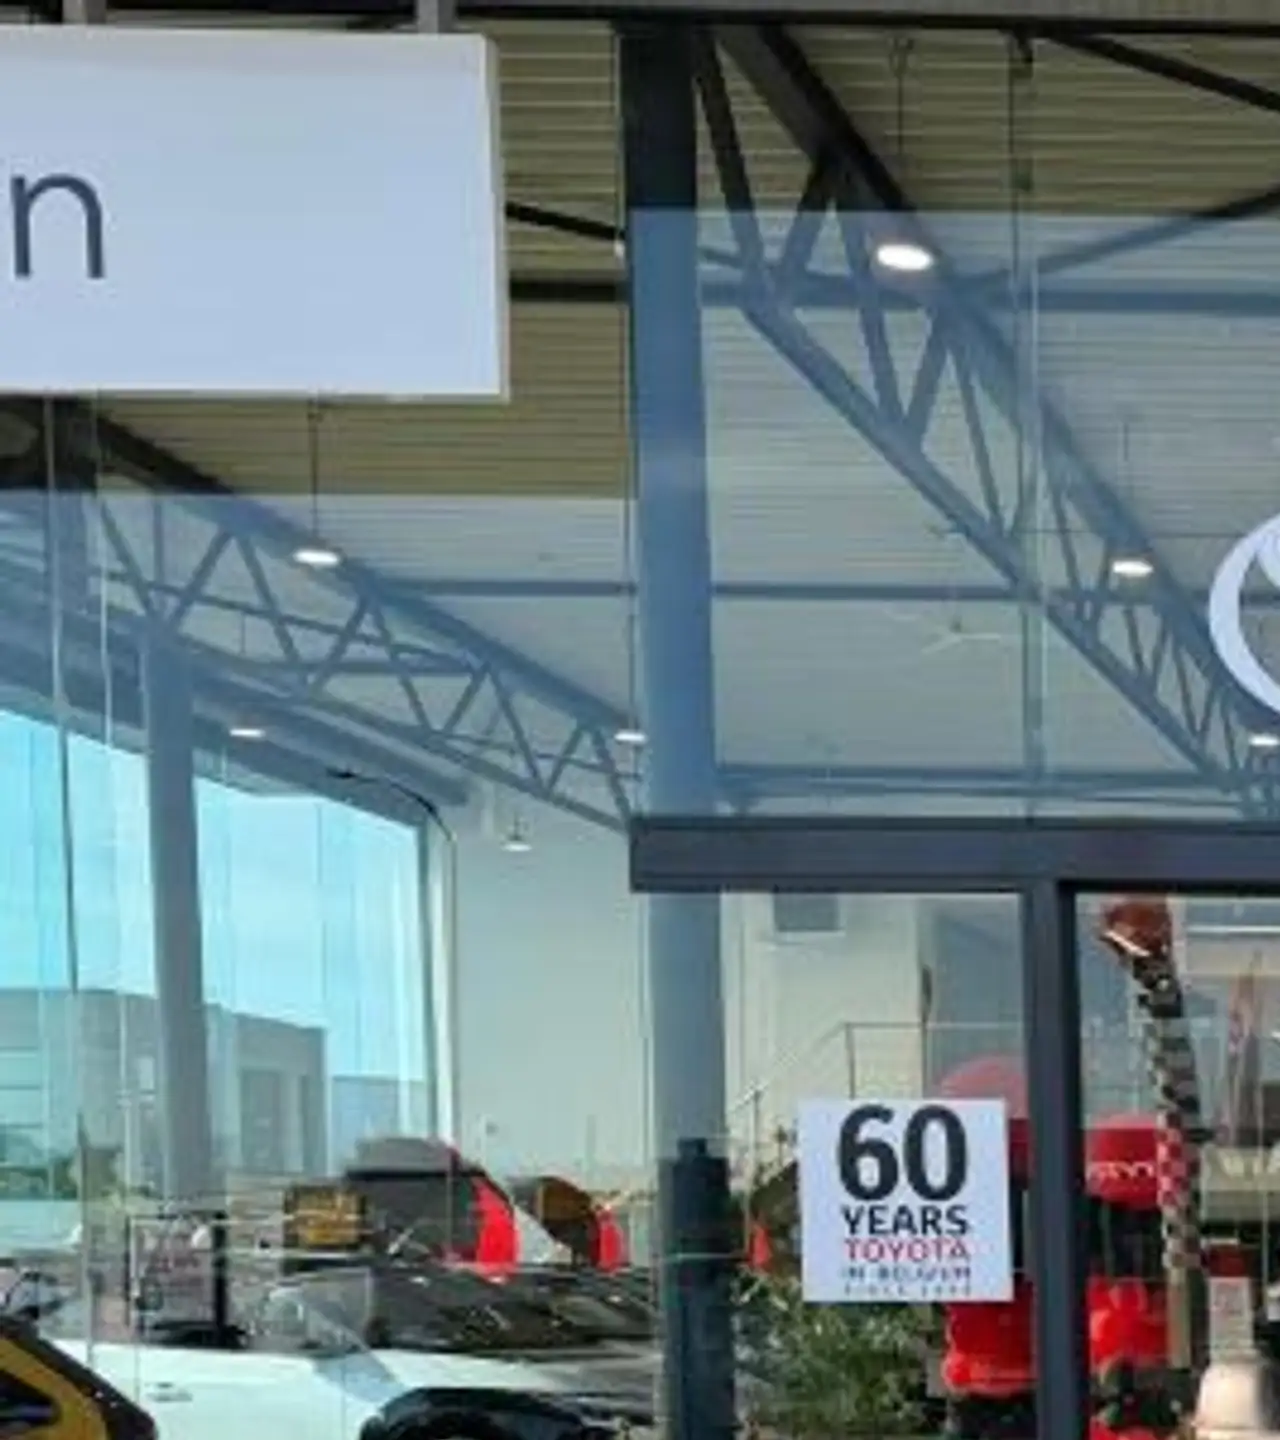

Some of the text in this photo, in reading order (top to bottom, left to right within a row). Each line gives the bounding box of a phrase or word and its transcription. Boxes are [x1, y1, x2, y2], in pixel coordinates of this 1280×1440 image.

[836, 1104, 968, 1202] 60
[842, 1205, 971, 1236] YEARS
[845, 1238, 972, 1264] TOYOTA
